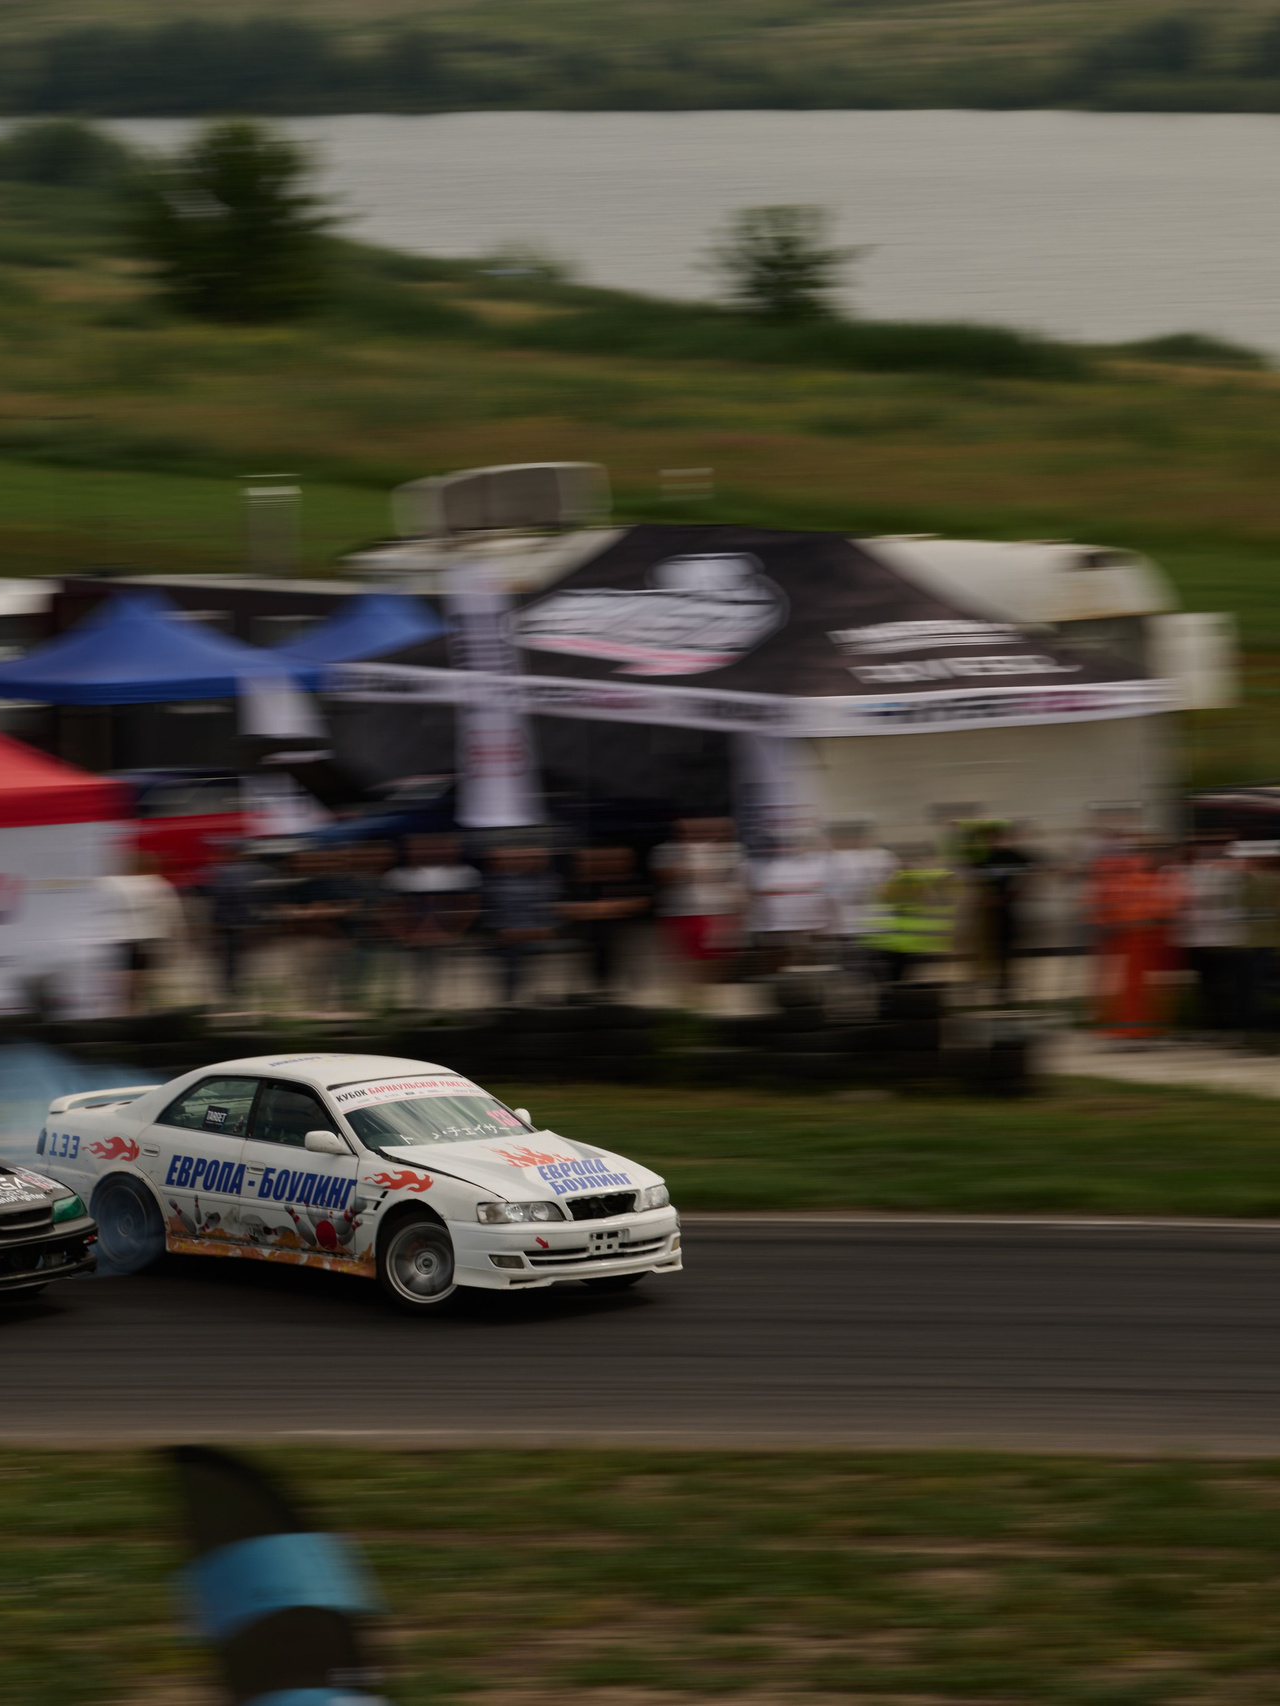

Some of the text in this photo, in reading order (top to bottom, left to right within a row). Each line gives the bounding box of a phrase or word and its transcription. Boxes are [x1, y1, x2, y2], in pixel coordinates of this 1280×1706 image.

[335, 1088, 368, 1103] КУБОК
[368, 1080, 440, 1094] БАРНАУЛЬСКОЙ
[440, 1080, 473, 1090] РАКЕТЫ
[486, 1108, 523, 1127] 133
[49, 1132, 81, 1159] 133
[536, 1158, 610, 1181] ЕВРОПА
[165, 1154, 247, 1195] ЕВРОПА
[257, 1167, 359, 1210] БОУЛИНГ
[549, 1172, 632, 1195] БОУЛИНГ
